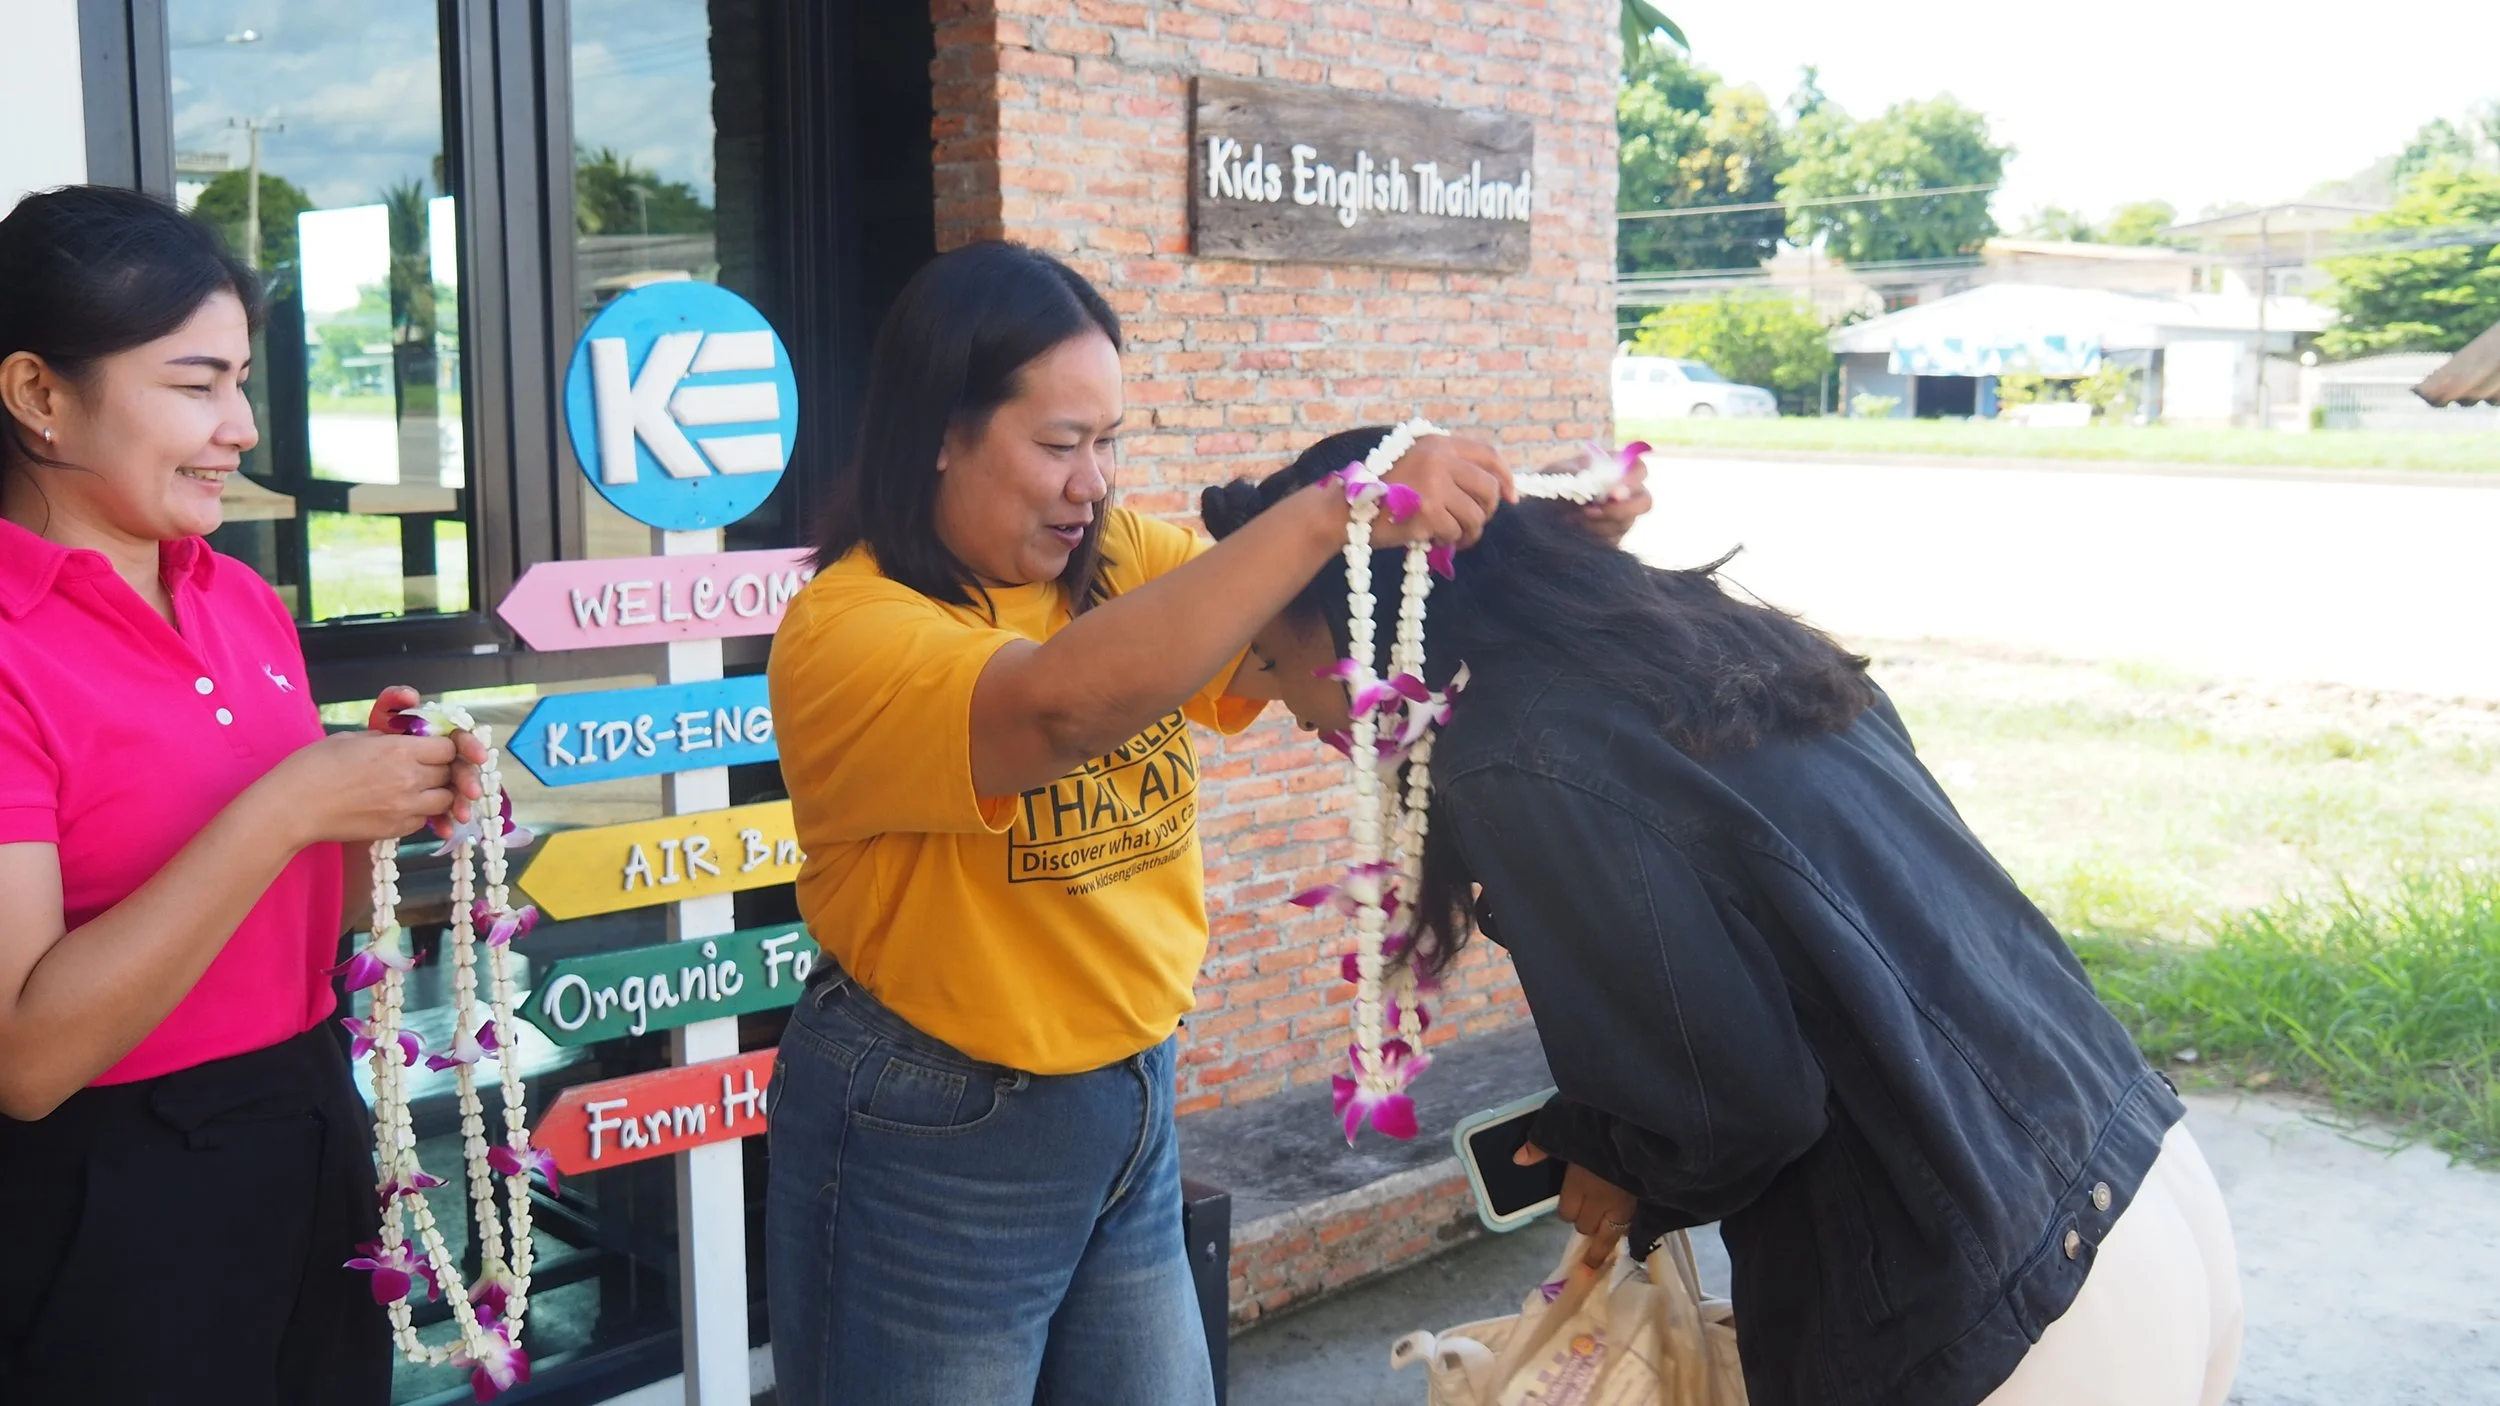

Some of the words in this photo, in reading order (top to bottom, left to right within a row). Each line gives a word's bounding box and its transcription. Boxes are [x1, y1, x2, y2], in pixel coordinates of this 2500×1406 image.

[1207, 135, 1282, 202] Kids
[1291, 143, 1408, 228] English
[1412, 158, 1531, 222] Thailand
[590, 330, 784, 485] KE
[570, 569, 815, 629] WELCOM
[623, 834, 720, 891] AIR
[738, 828, 807, 873] Bn
[1022, 843, 1106, 872] Discover
[1109, 829, 1151, 856] what
[1154, 815, 1178, 849] you
[543, 941, 744, 1037] Organic
[759, 931, 813, 989] Fo
[585, 1098, 706, 1161] Farm
